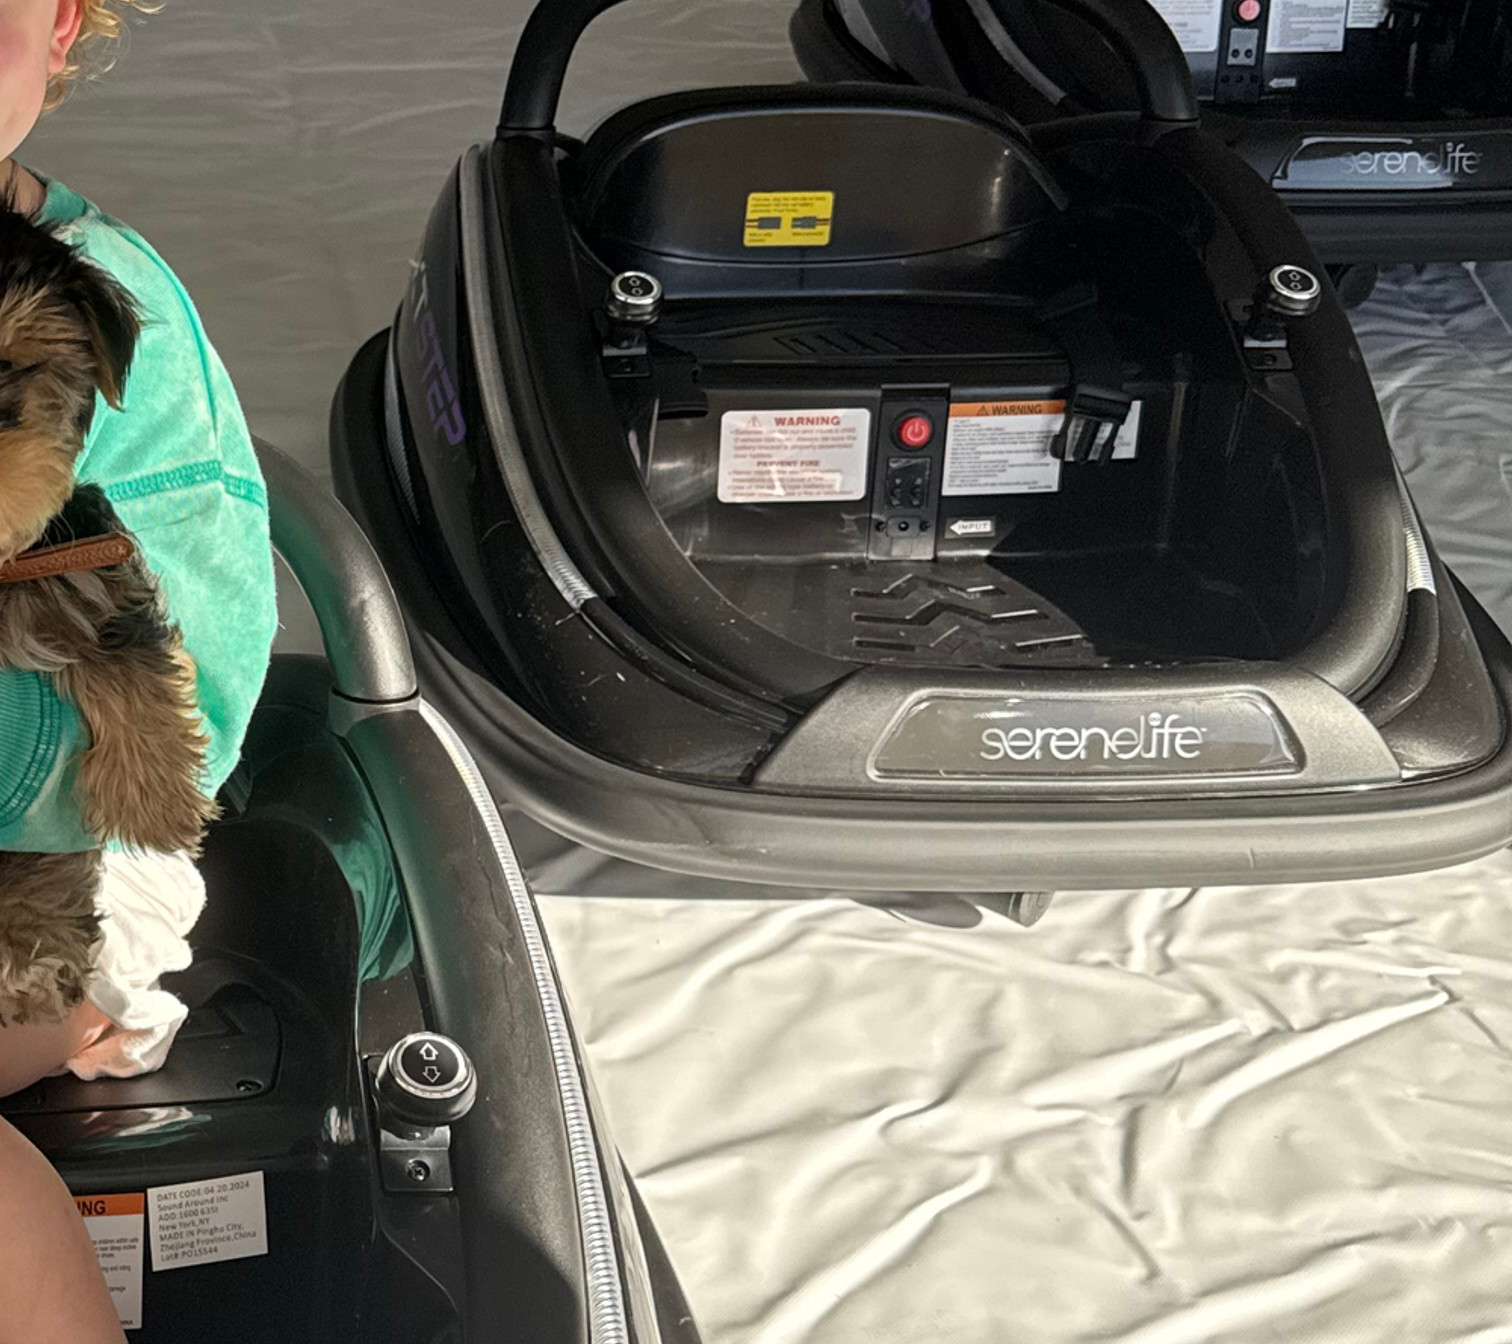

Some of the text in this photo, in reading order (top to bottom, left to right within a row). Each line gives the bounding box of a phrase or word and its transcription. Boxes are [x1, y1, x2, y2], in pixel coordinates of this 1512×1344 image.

[991, 404, 1043, 415] WARNING
[774, 416, 841, 426] WARNING
[980, 712, 1204, 760] serenelife
[157, 1192, 177, 1202] DATE
[157, 1201, 183, 1212] Sound
[184, 1197, 215, 1208] Around
[159, 1223, 177, 1232] New
[159, 1231, 184, 1242] MADE
[184, 1229, 195, 1237] IN
